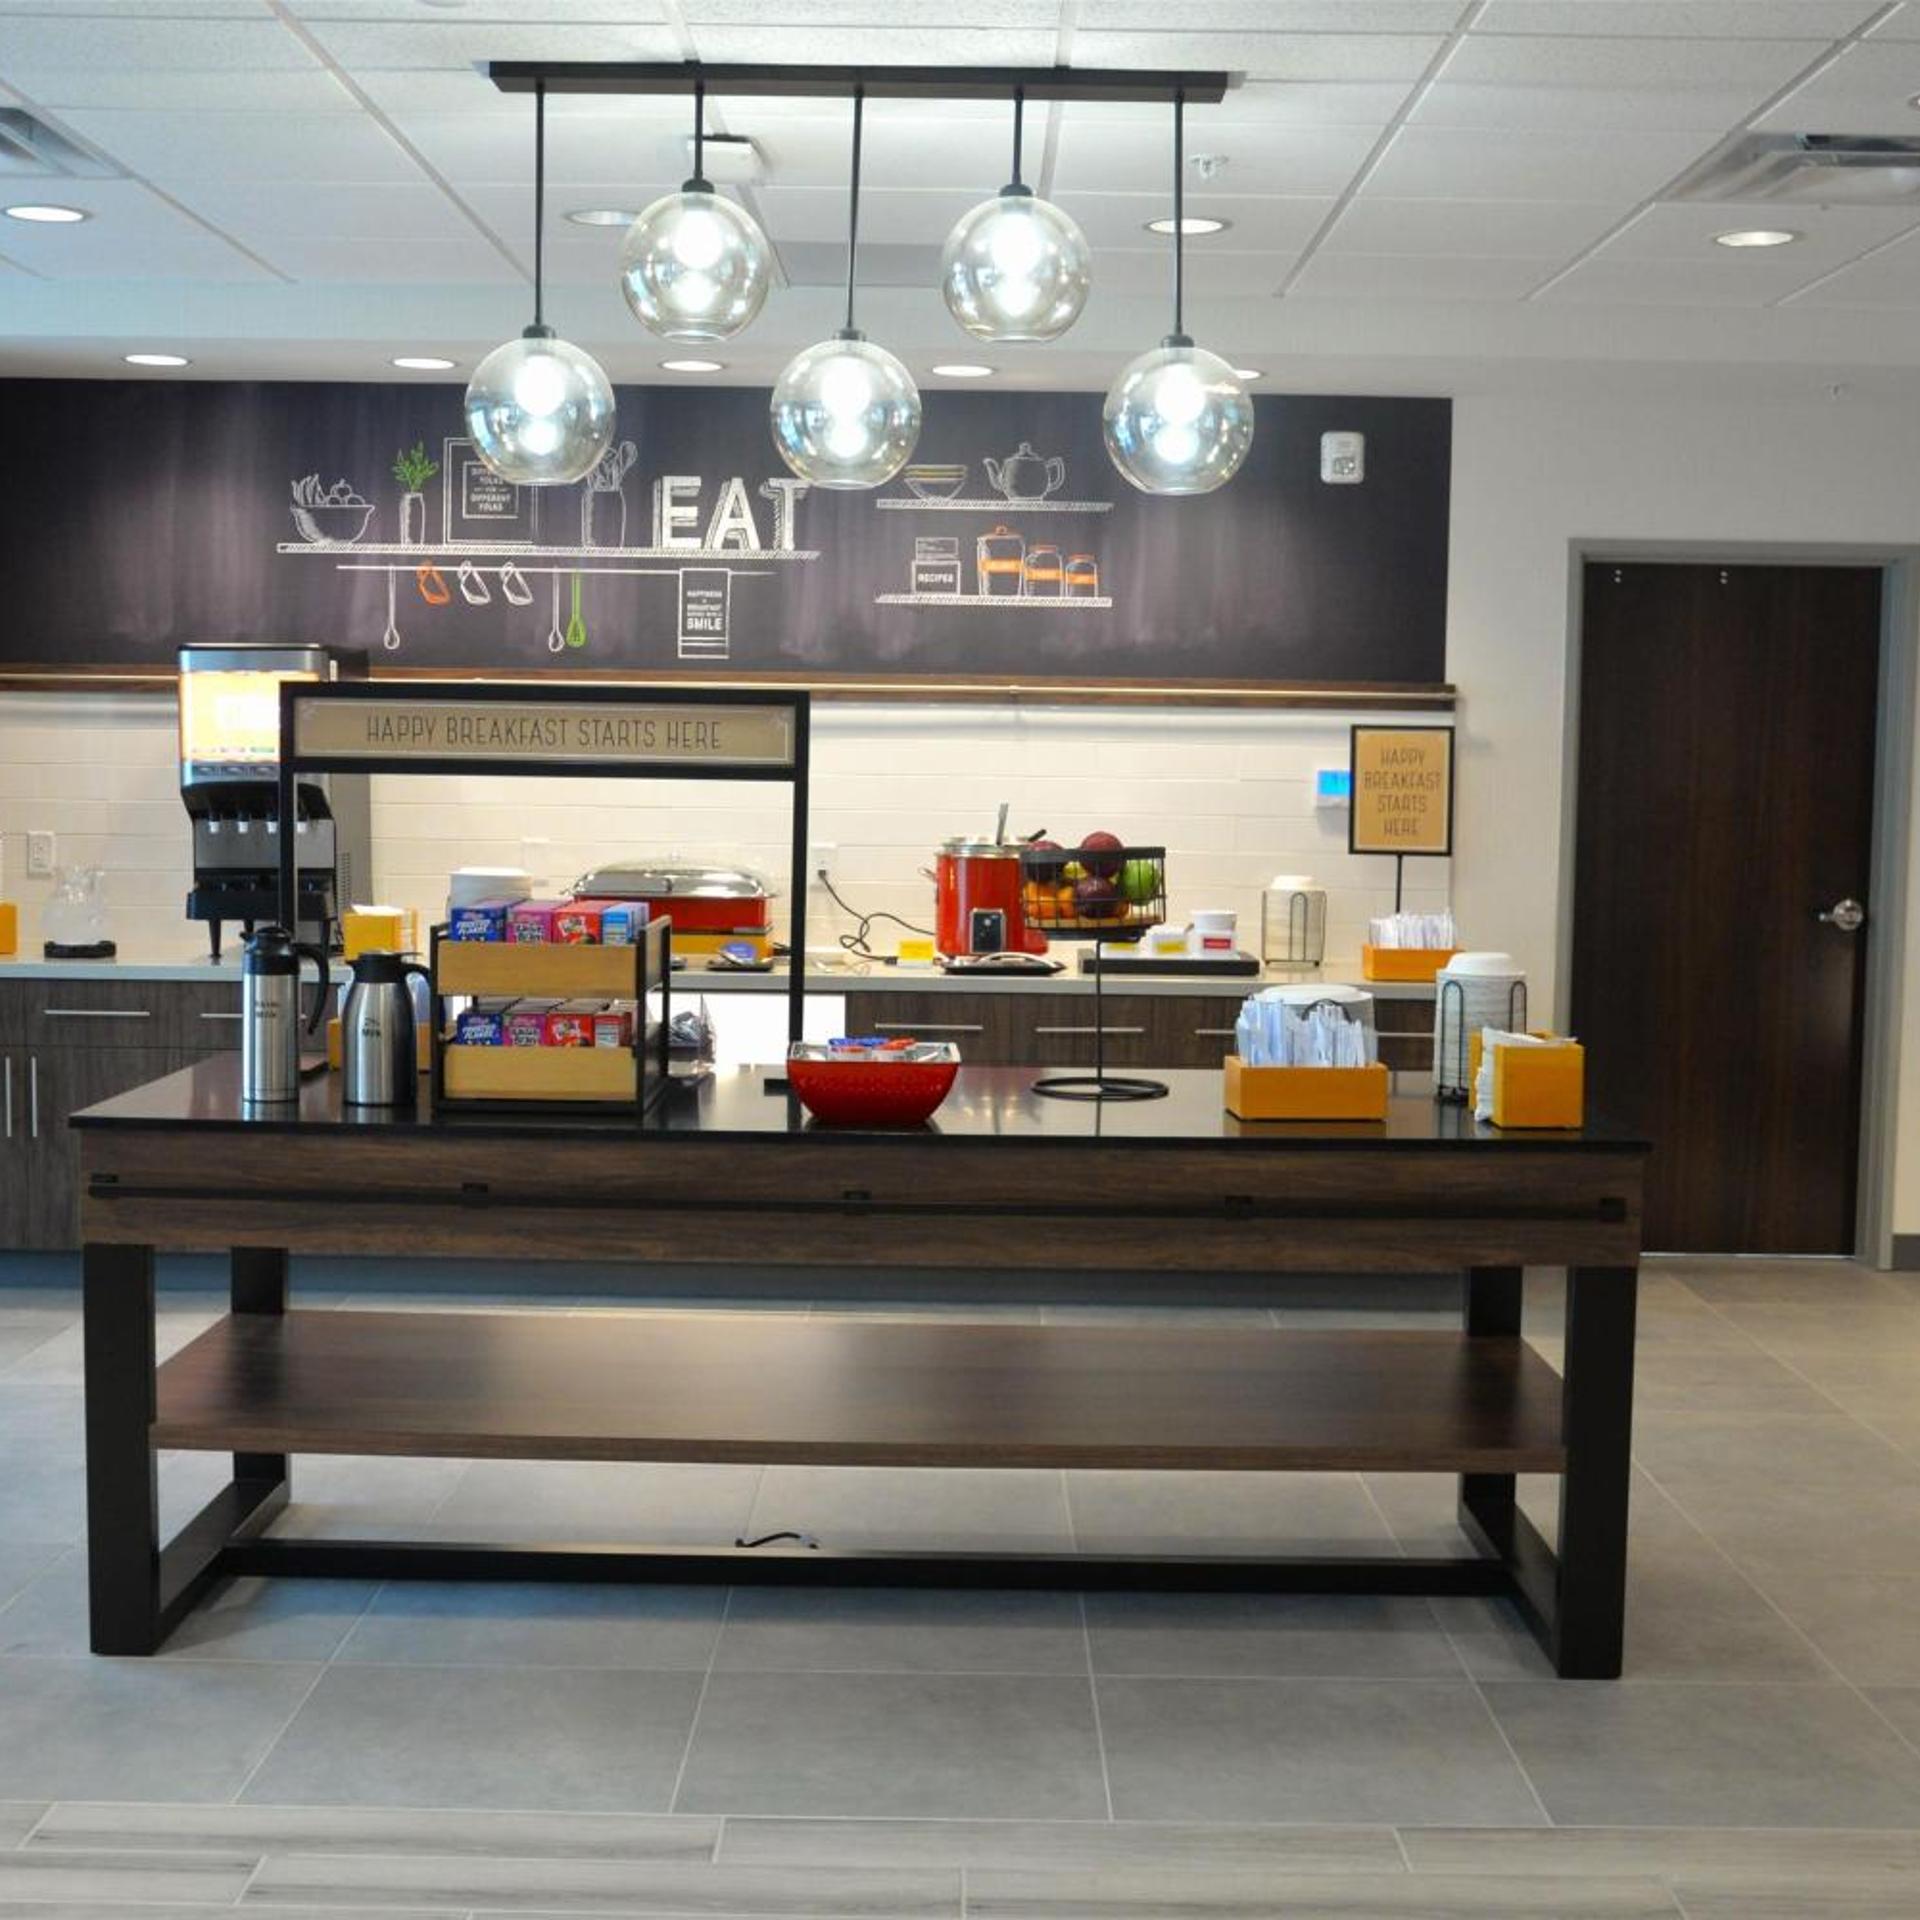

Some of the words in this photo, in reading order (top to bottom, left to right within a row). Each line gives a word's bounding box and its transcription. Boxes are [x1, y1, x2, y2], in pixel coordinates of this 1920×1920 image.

[653, 475, 811, 551] EAT
[918, 573, 953, 583] RECIPES
[687, 617, 722, 630] SMILE
[367, 715, 437, 743] HAPPY
[446, 717, 569, 746] BREAKFAST
[578, 719, 656, 748] STARTS
[667, 721, 721, 749] HERE
[1381, 748, 1425, 767] HAPPY
[1364, 771, 1441, 791] BREAKFAST
[1378, 794, 1426, 813] STARTS
[1384, 818, 1418, 836] HERE
